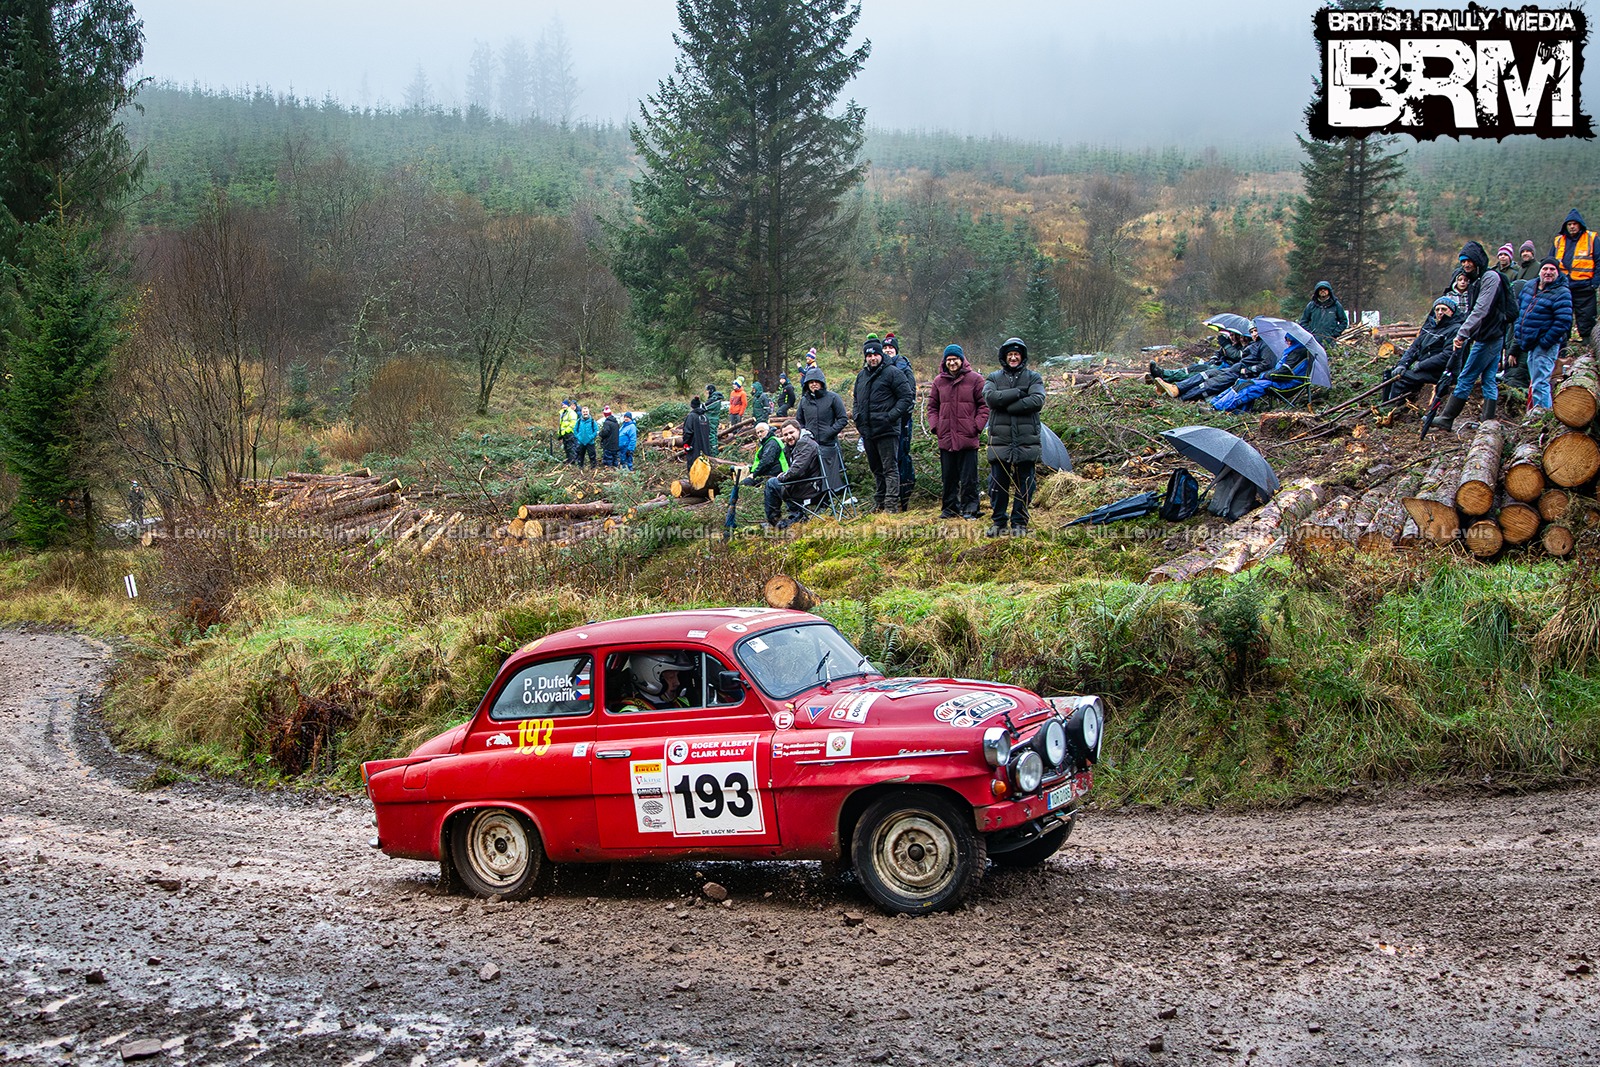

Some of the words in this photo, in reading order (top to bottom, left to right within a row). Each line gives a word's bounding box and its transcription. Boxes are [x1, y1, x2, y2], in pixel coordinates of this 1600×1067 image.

[524, 678, 535, 690] P.
[538, 674, 573, 690] Dufek
[779, 713, 788, 726] E
[514, 718, 555, 756] 193
[691, 741, 720, 750] ROGER
[721, 739, 754, 748] ALBERT
[691, 750, 718, 758] CLARK
[720, 748, 746, 757] RALLY
[674, 772, 753, 818] 193
